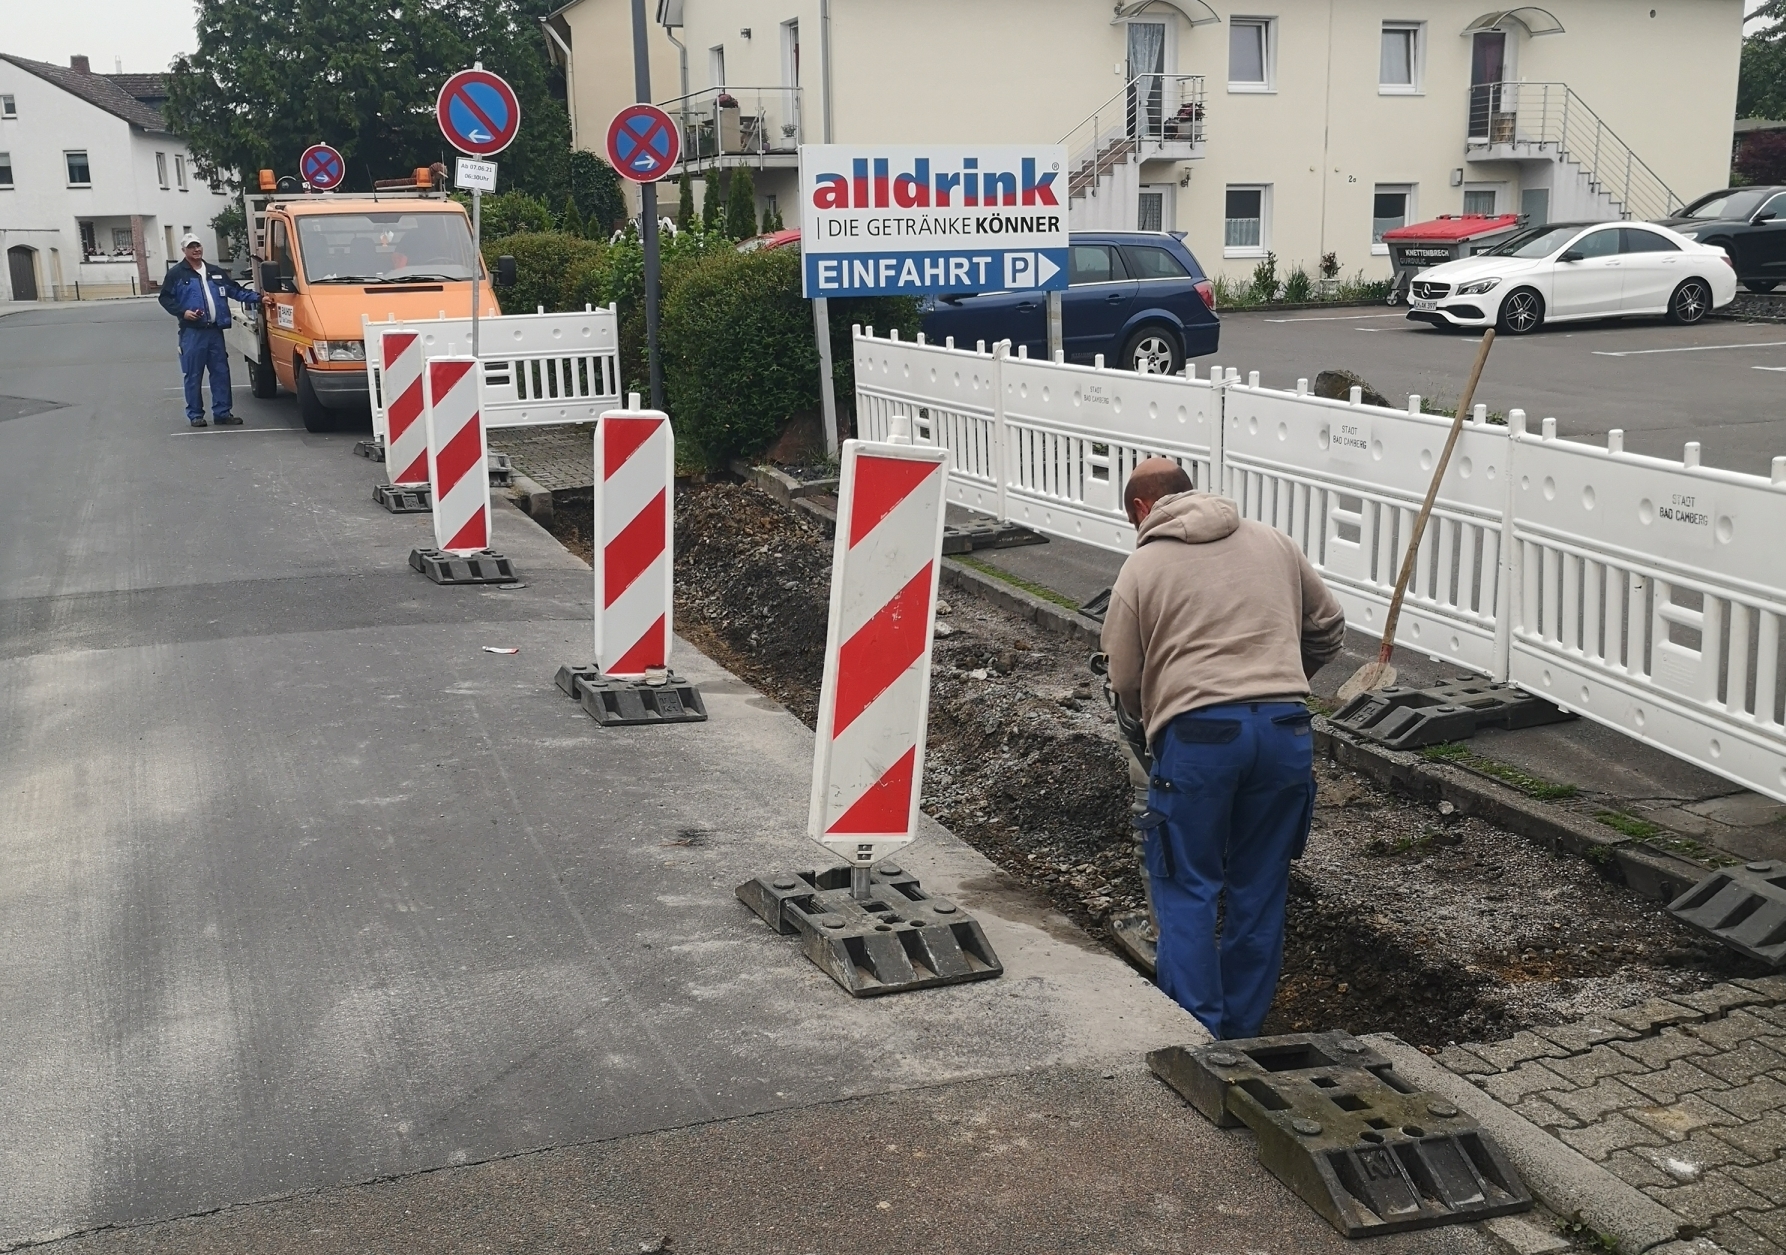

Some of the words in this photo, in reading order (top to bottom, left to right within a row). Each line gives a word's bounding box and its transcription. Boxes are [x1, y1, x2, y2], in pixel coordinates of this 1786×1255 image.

[828, 218, 859, 237] DIE
[1405, 249, 1449, 257] KNETTENBRECH
[818, 256, 992, 289] EINFAHRT
[1341, 425, 1358, 435] STADT
[1333, 435, 1343, 445] BAD
[1343, 437, 1367, 449] CAMBERG
[1672, 494, 1696, 508] STADT
[1659, 506, 1673, 520] BAD
[1675, 510, 1708, 526] CAMBERG
